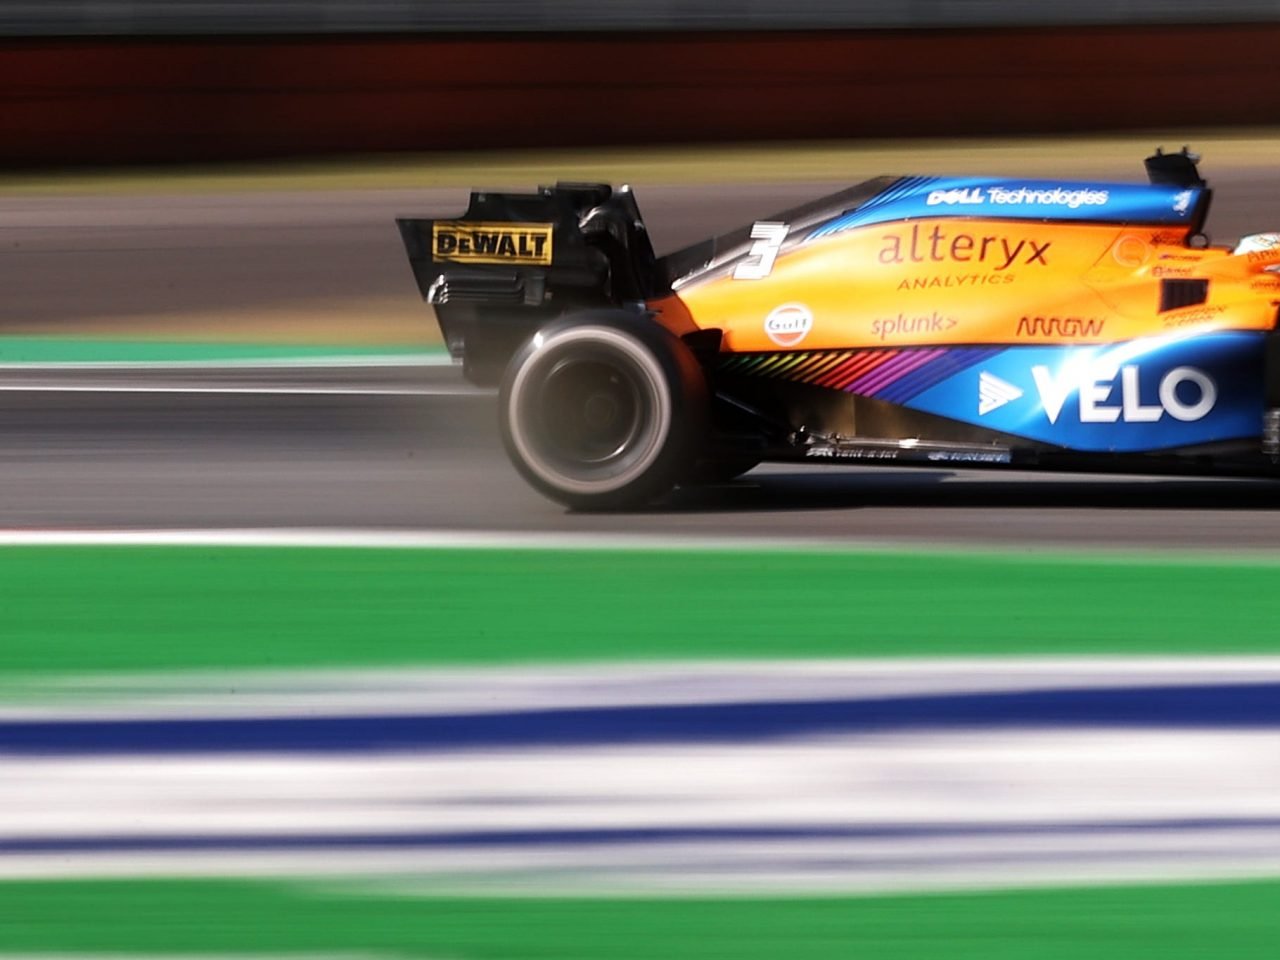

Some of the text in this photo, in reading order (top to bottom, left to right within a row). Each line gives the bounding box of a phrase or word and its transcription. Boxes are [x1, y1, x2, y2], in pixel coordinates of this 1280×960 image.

[926, 187, 1109, 208] DELL Technologies
[733, 221, 791, 280] 3
[879, 224, 1051, 271] alteryx
[897, 273, 1015, 290] ANALYTICS
[768, 318, 808, 330] Gulf
[1016, 316, 1104, 337] ARROW
[1031, 364, 1218, 425] VELO
